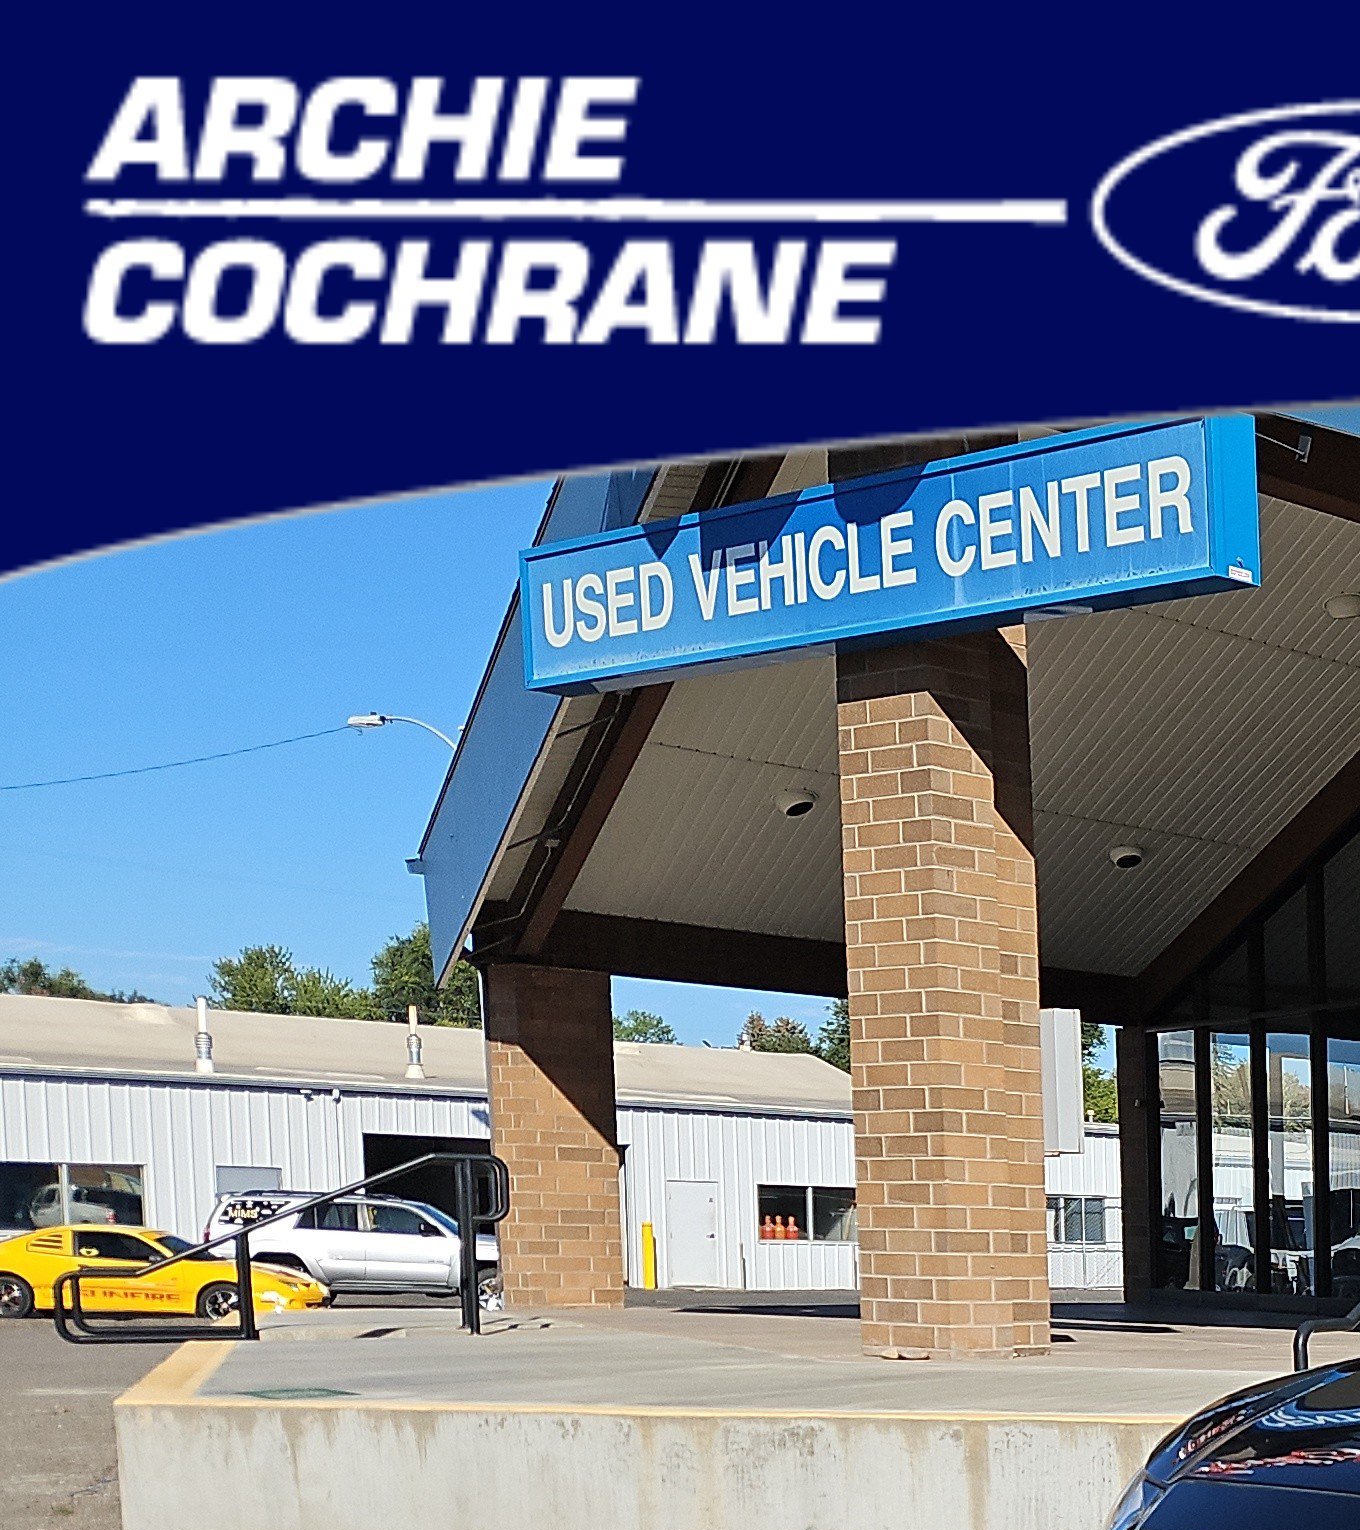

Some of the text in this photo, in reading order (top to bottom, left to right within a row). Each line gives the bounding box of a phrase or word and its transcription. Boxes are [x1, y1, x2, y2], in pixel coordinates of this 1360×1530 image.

[543, 456, 1194, 648] USED VEHICLE CENTER
